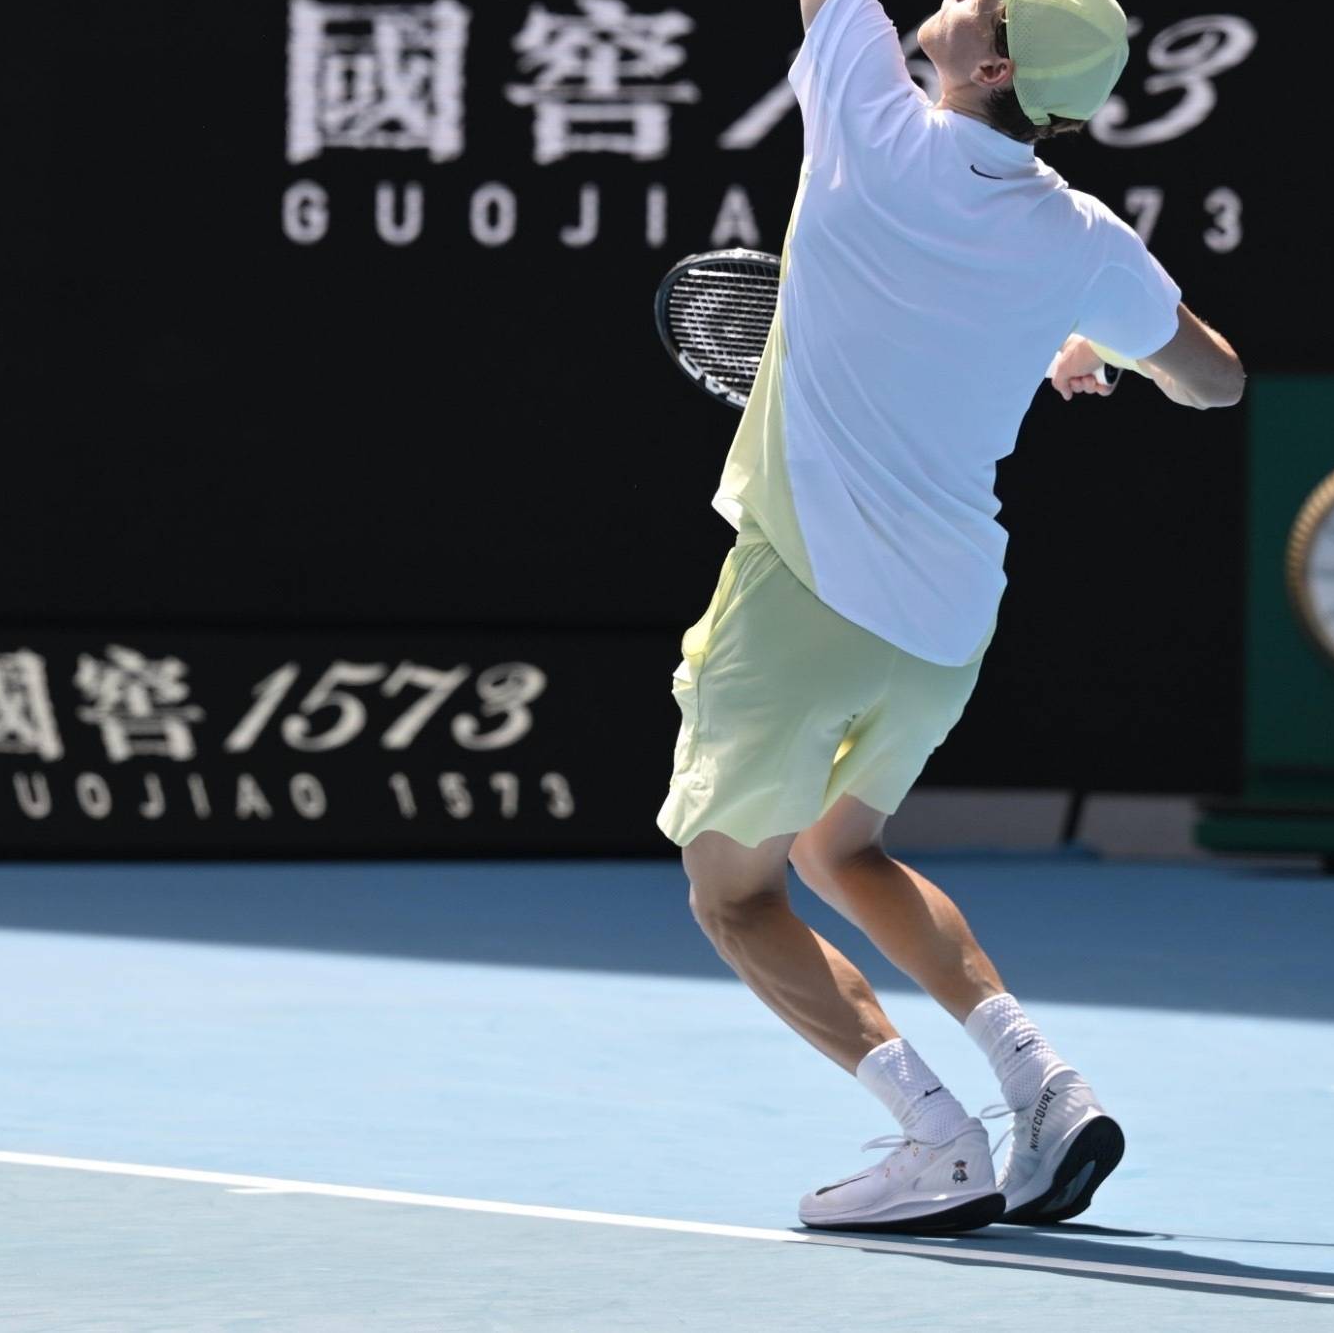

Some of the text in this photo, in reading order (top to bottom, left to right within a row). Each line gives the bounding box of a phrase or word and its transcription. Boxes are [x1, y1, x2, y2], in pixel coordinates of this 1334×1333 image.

[281, 180, 760, 247] GUOJIA
[223, 660, 548, 752] 1573
[388, 771, 575, 820] 1573
[1029, 1086, 1057, 1152] NIKECOURT
